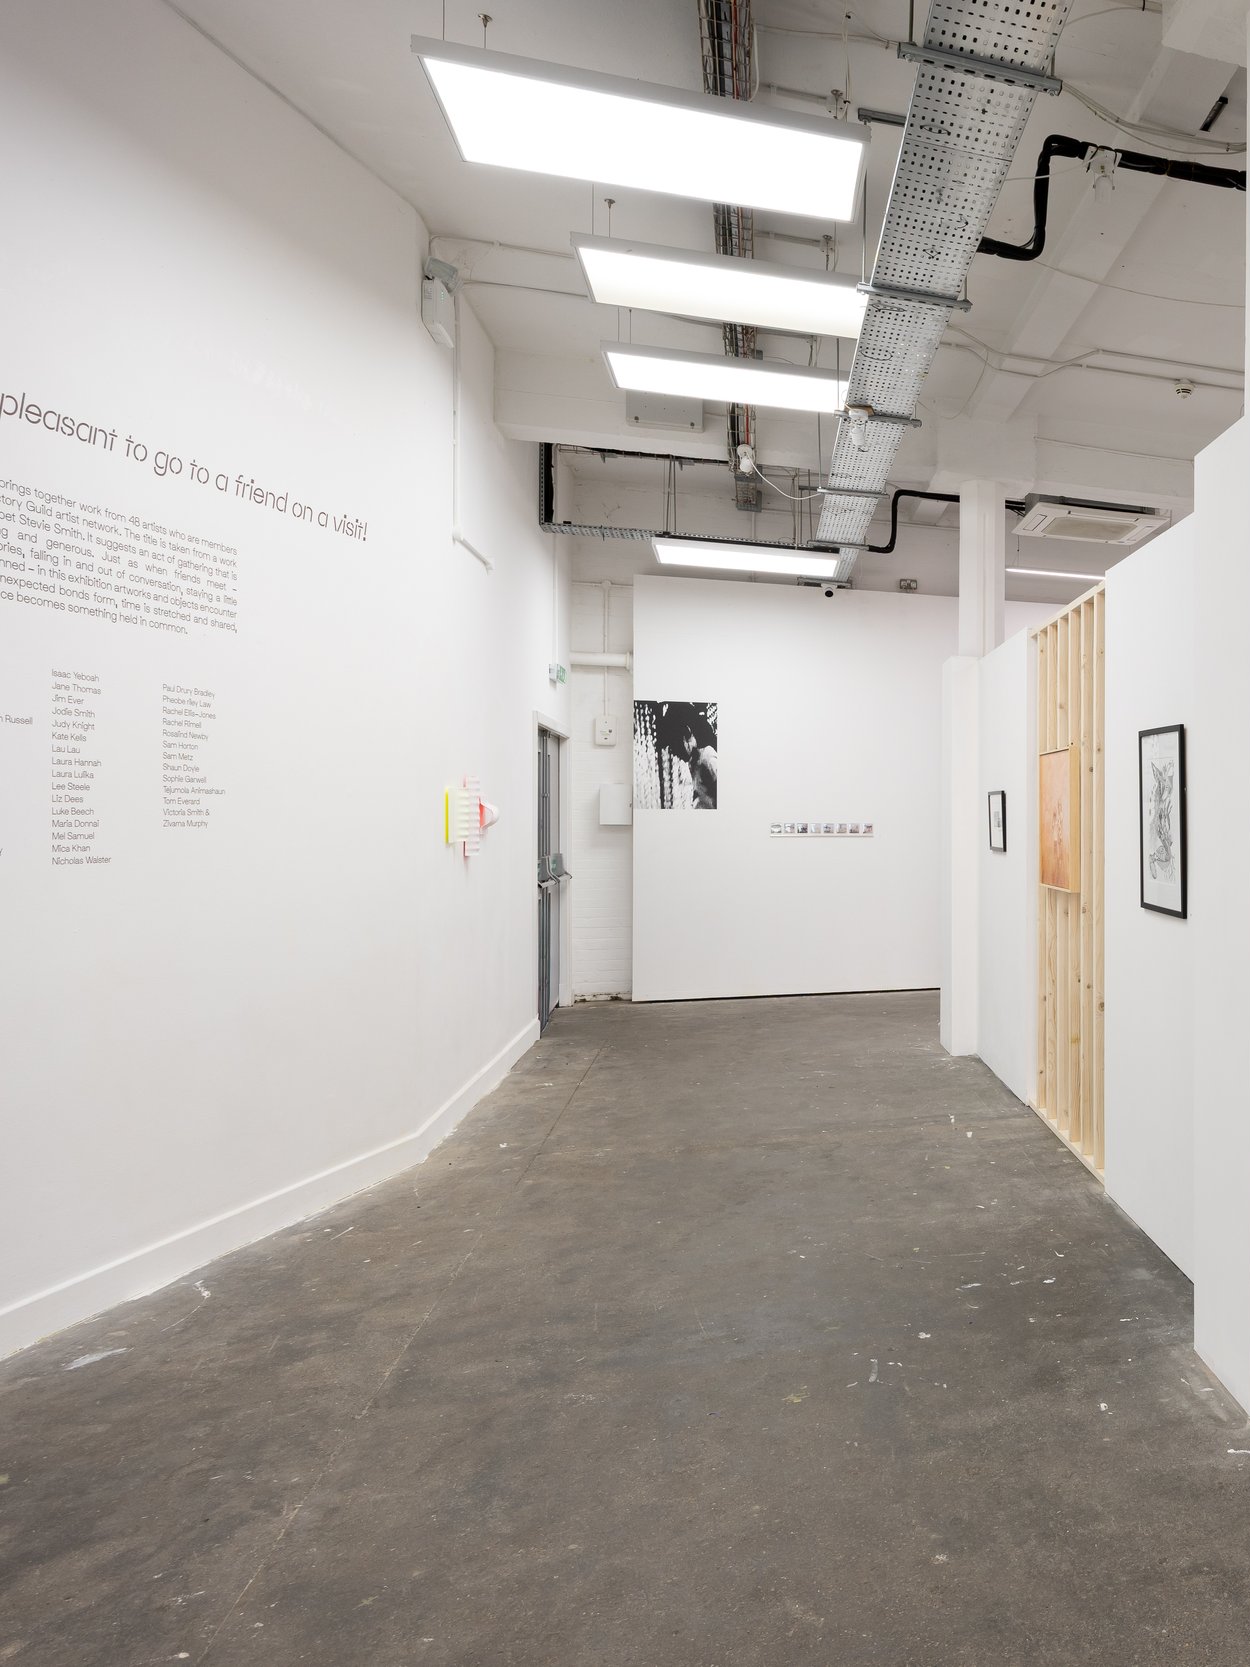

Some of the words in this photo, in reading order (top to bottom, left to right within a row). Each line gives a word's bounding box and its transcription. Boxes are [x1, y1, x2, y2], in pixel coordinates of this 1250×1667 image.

[0, 393, 118, 451] pleasant
[125, 438, 147, 462] to
[154, 451, 182, 476] go
[190, 463, 209, 484] to
[216, 474, 228, 492] a
[235, 480, 288, 513] friend
[292, 502, 313, 522] on
[318, 512, 328, 528] a
[334, 516, 367, 541] visit!
[34, 488, 77, 508] together
[79, 503, 102, 516] work
[104, 508, 126, 523] from
[128, 516, 140, 527] 48
[142, 522, 167, 535] artists
[169, 529, 186, 540] who
[187, 535, 200, 544] are
[201, 539, 237, 555] members
[0, 494, 23, 511] tory
[26, 500, 52, 517] Guild
[55, 511, 79, 524] artist
[82, 519, 122, 536] network.
[124, 527, 140, 541] The
[143, 534, 157, 546] title
[160, 538, 167, 548] is
[169, 542, 190, 555] taken
[192, 547, 210, 561] from
[220, 558, 237, 568] work
[19, 514, 51, 531] Stevie
[54, 523, 85, 541] Smith.
[87, 532, 93, 543] It
[96, 537, 136, 554] suggests
[139, 549, 149, 558] an
[152, 552, 165, 562] act
[167, 555, 175, 564] of
[177, 559, 213, 577] gathering
[215, 568, 229, 579] that
[231, 570, 238, 581] is
[17, 532, 37, 543] and
[46, 539, 94, 558] generous.
[102, 551, 120, 564] Just
[128, 560, 138, 568] as
[145, 564, 167, 576] when
[174, 569, 201, 584] friends
[207, 580, 226, 591] meet
[30, 548, 59, 567] falling
[63, 555, 71, 567] in
[76, 561, 94, 572] and
[97, 567, 113, 576] out
[116, 570, 125, 579] of
[129, 574, 183, 596] conversation,
[186, 588, 213, 603] staying
[37, 564, 46, 576] in
[48, 568, 66, 581] this
[68, 574, 112, 590] exhibition
[114, 585, 151, 599] artworks
[153, 594, 169, 603] and
[170, 597, 198, 610] objects
[200, 604, 237, 618] encounter
[17, 591, 65, 610] becomes
[68, 604, 117, 623] something
[119, 612, 138, 624] held
[140, 616, 147, 626] in
[149, 620, 188, 634] common.
[57, 585, 90, 600] bonds
[93, 592, 118, 609] form,
[121, 598, 141, 611] time
[144, 603, 151, 613] is
[153, 607, 191, 622] stretched
[193, 616, 208, 625] and
[210, 618, 237, 634] shared,
[52, 669, 71, 679] Isaac
[73, 672, 99, 682] Yeboah
[52, 681, 70, 691] Jane
[72, 683, 101, 695] Thomas
[52, 694, 66, 702] Jim
[68, 695, 84, 704] Ever
[52, 707, 72, 716] Jodie
[74, 708, 95, 718] Smith
[5, 714, 33, 725] Russell
[52, 720, 70, 730] Judy
[72, 721, 95, 732] Knight
[52, 732, 69, 740] Kate
[52, 744, 65, 753] Lau
[67, 745, 80, 753] Lau
[52, 757, 72, 765] Laura
[74, 758, 102, 767] Hannah
[52, 769, 72, 778] Laura
[163, 774, 183, 783] Sophie
[52, 782, 66, 790] Lee
[67, 782, 90, 791] Steele
[52, 794, 63, 803] Liz
[64, 794, 84, 803] Dees
[52, 807, 69, 815] Luke
[71, 807, 94, 815] Beech
[52, 819, 73, 827] Maria
[52, 832, 65, 840] Mel
[67, 832, 95, 840] Samuel
[52, 844, 70, 852] Mica
[72, 844, 90, 852] Khan
[52, 857, 84, 865] Nicholas
